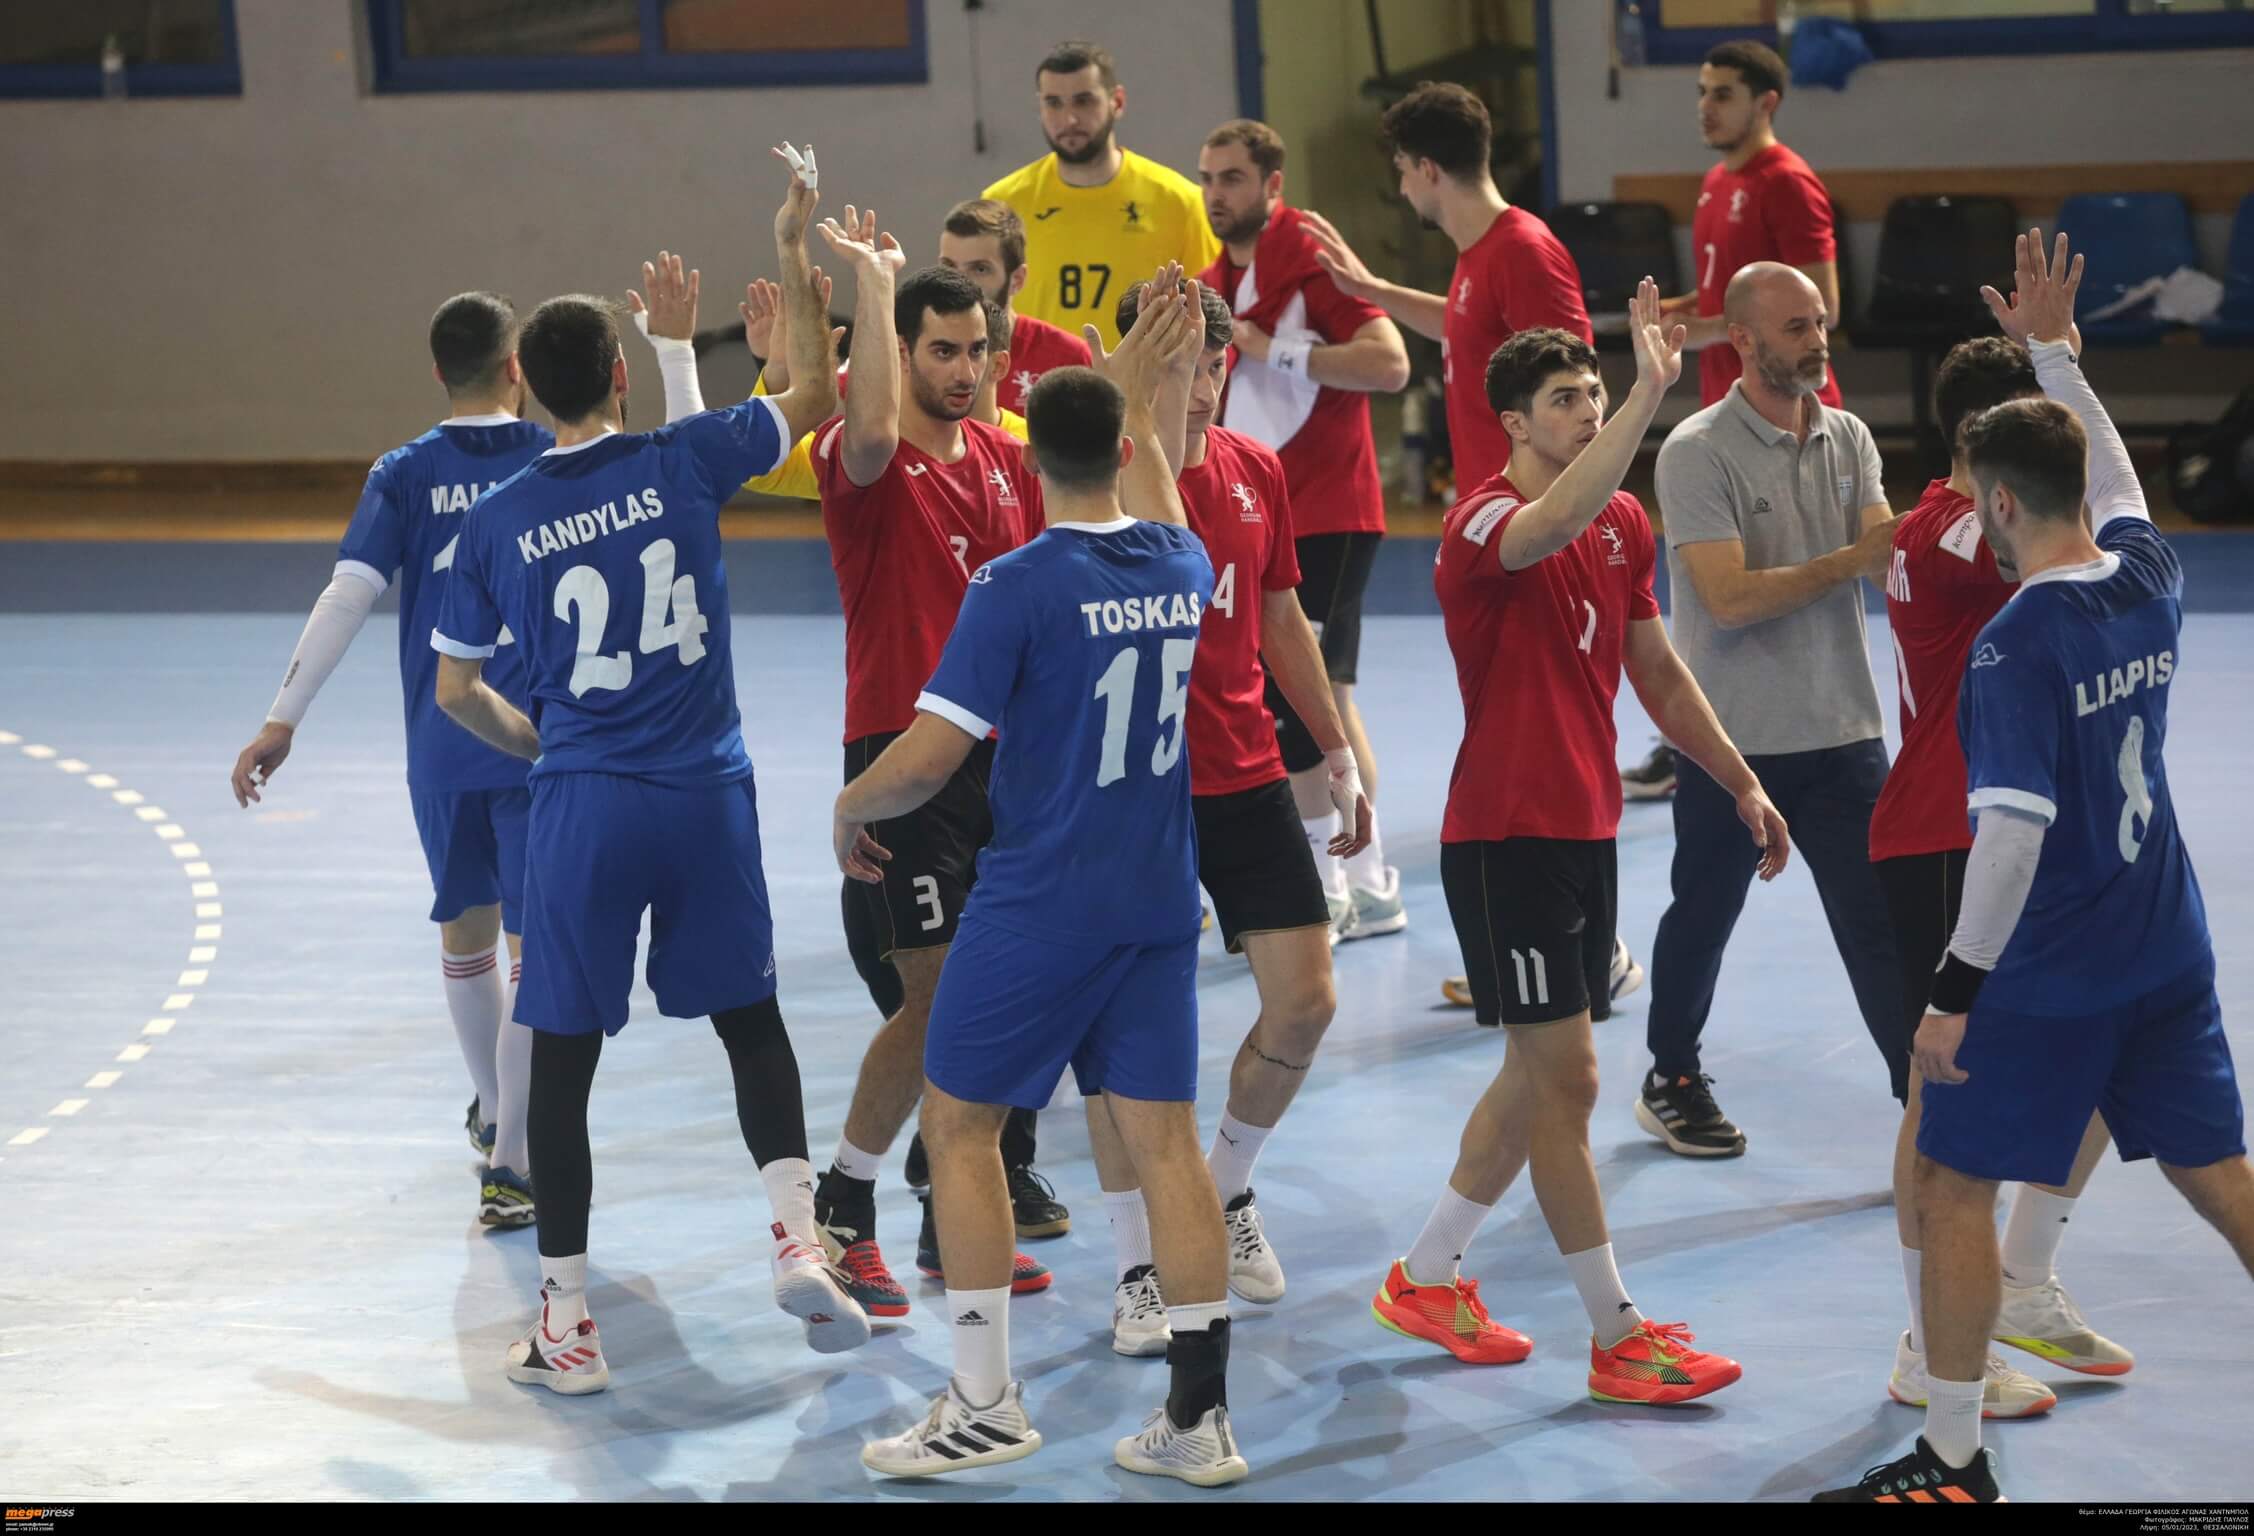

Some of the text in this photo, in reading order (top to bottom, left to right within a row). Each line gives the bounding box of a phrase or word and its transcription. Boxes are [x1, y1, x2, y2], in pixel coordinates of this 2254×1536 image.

[1058, 263, 1113, 311] 87
[517, 487, 665, 564] KANDYLAS
[553, 537, 710, 700] 24
[1080, 592, 1202, 637] TOSKAS
[1093, 638, 1197, 789] 15
[2075, 649, 2175, 718] LIAPIS
[912, 874, 944, 932] 3
[1510, 946, 1549, 1006] 11
